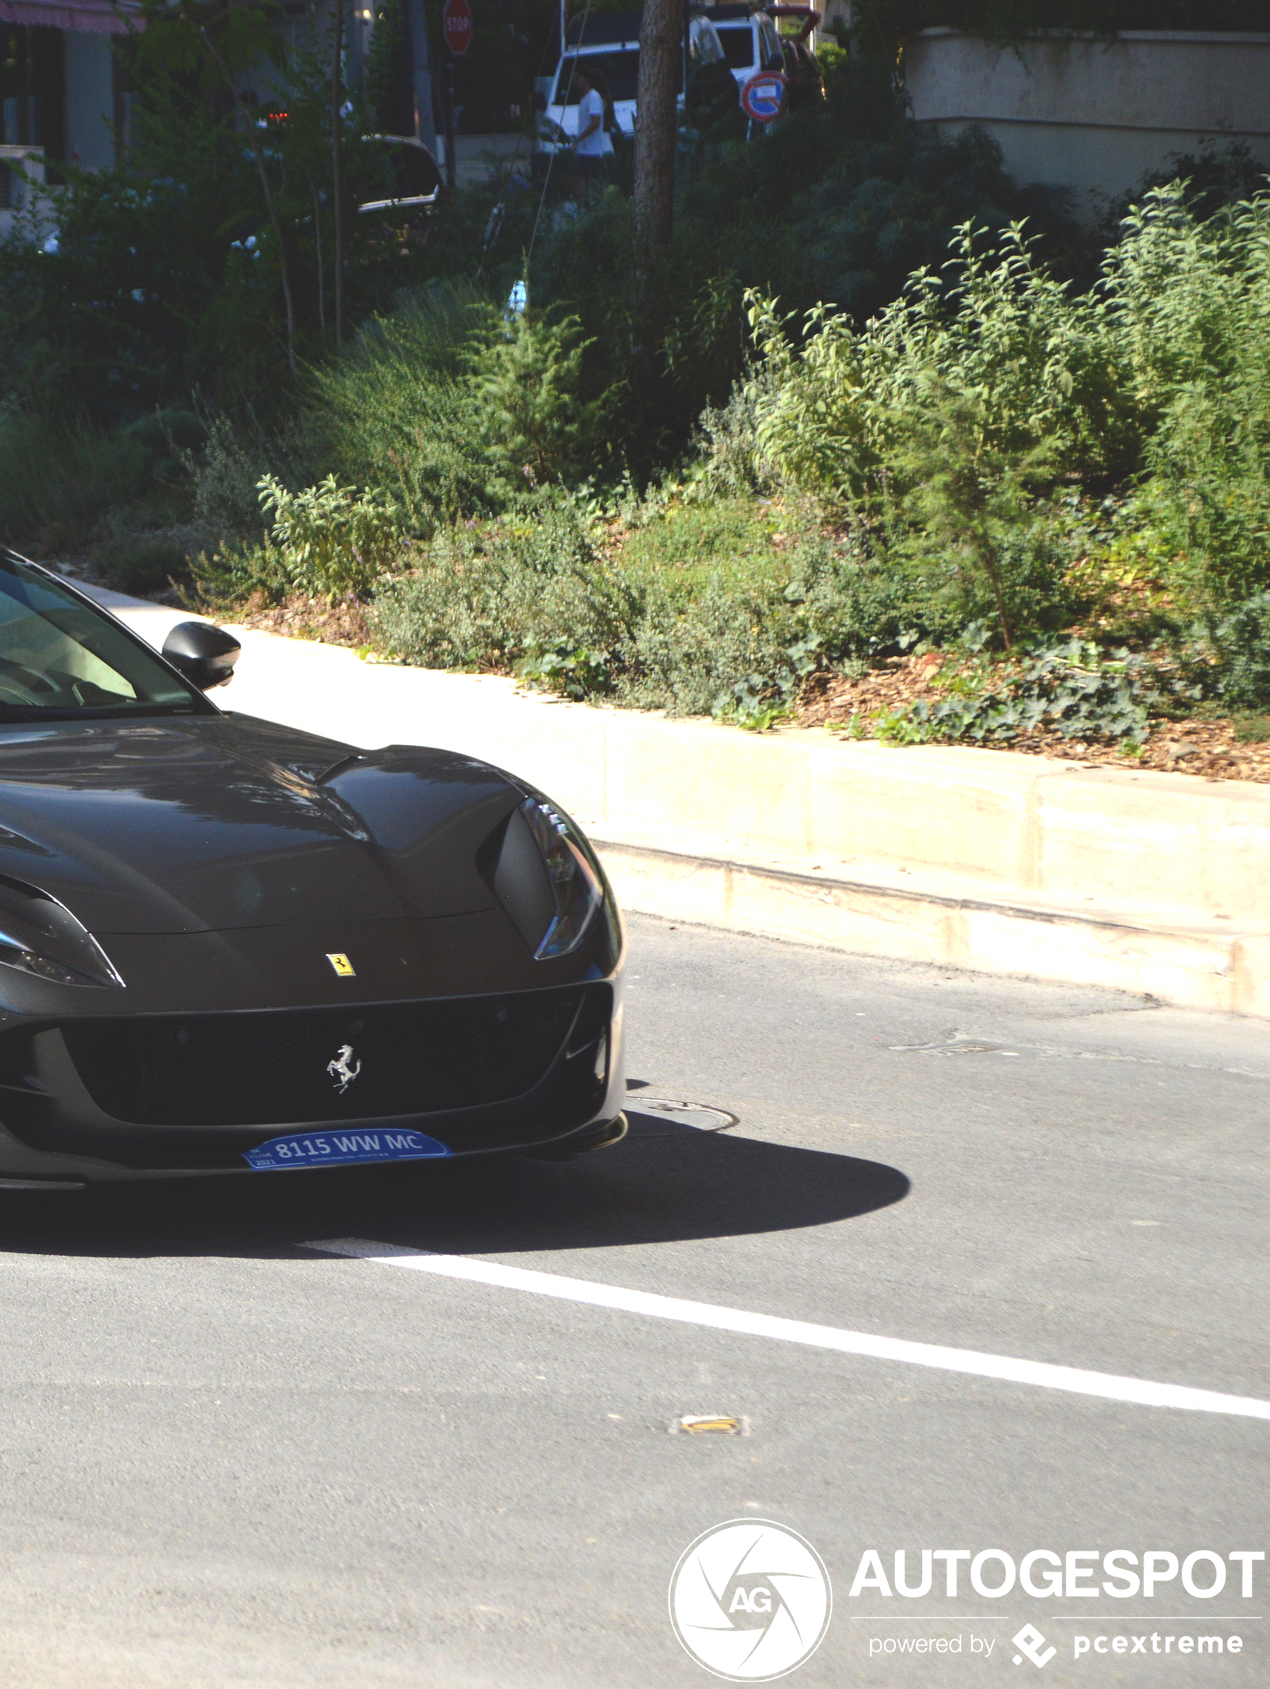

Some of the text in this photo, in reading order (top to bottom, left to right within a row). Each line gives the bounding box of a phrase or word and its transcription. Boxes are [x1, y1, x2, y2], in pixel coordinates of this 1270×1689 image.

[446, 16, 469, 31] STOP
[275, 1138, 331, 1159] 8115
[332, 1134, 380, 1153] WW
[384, 1134, 423, 1150] MC
